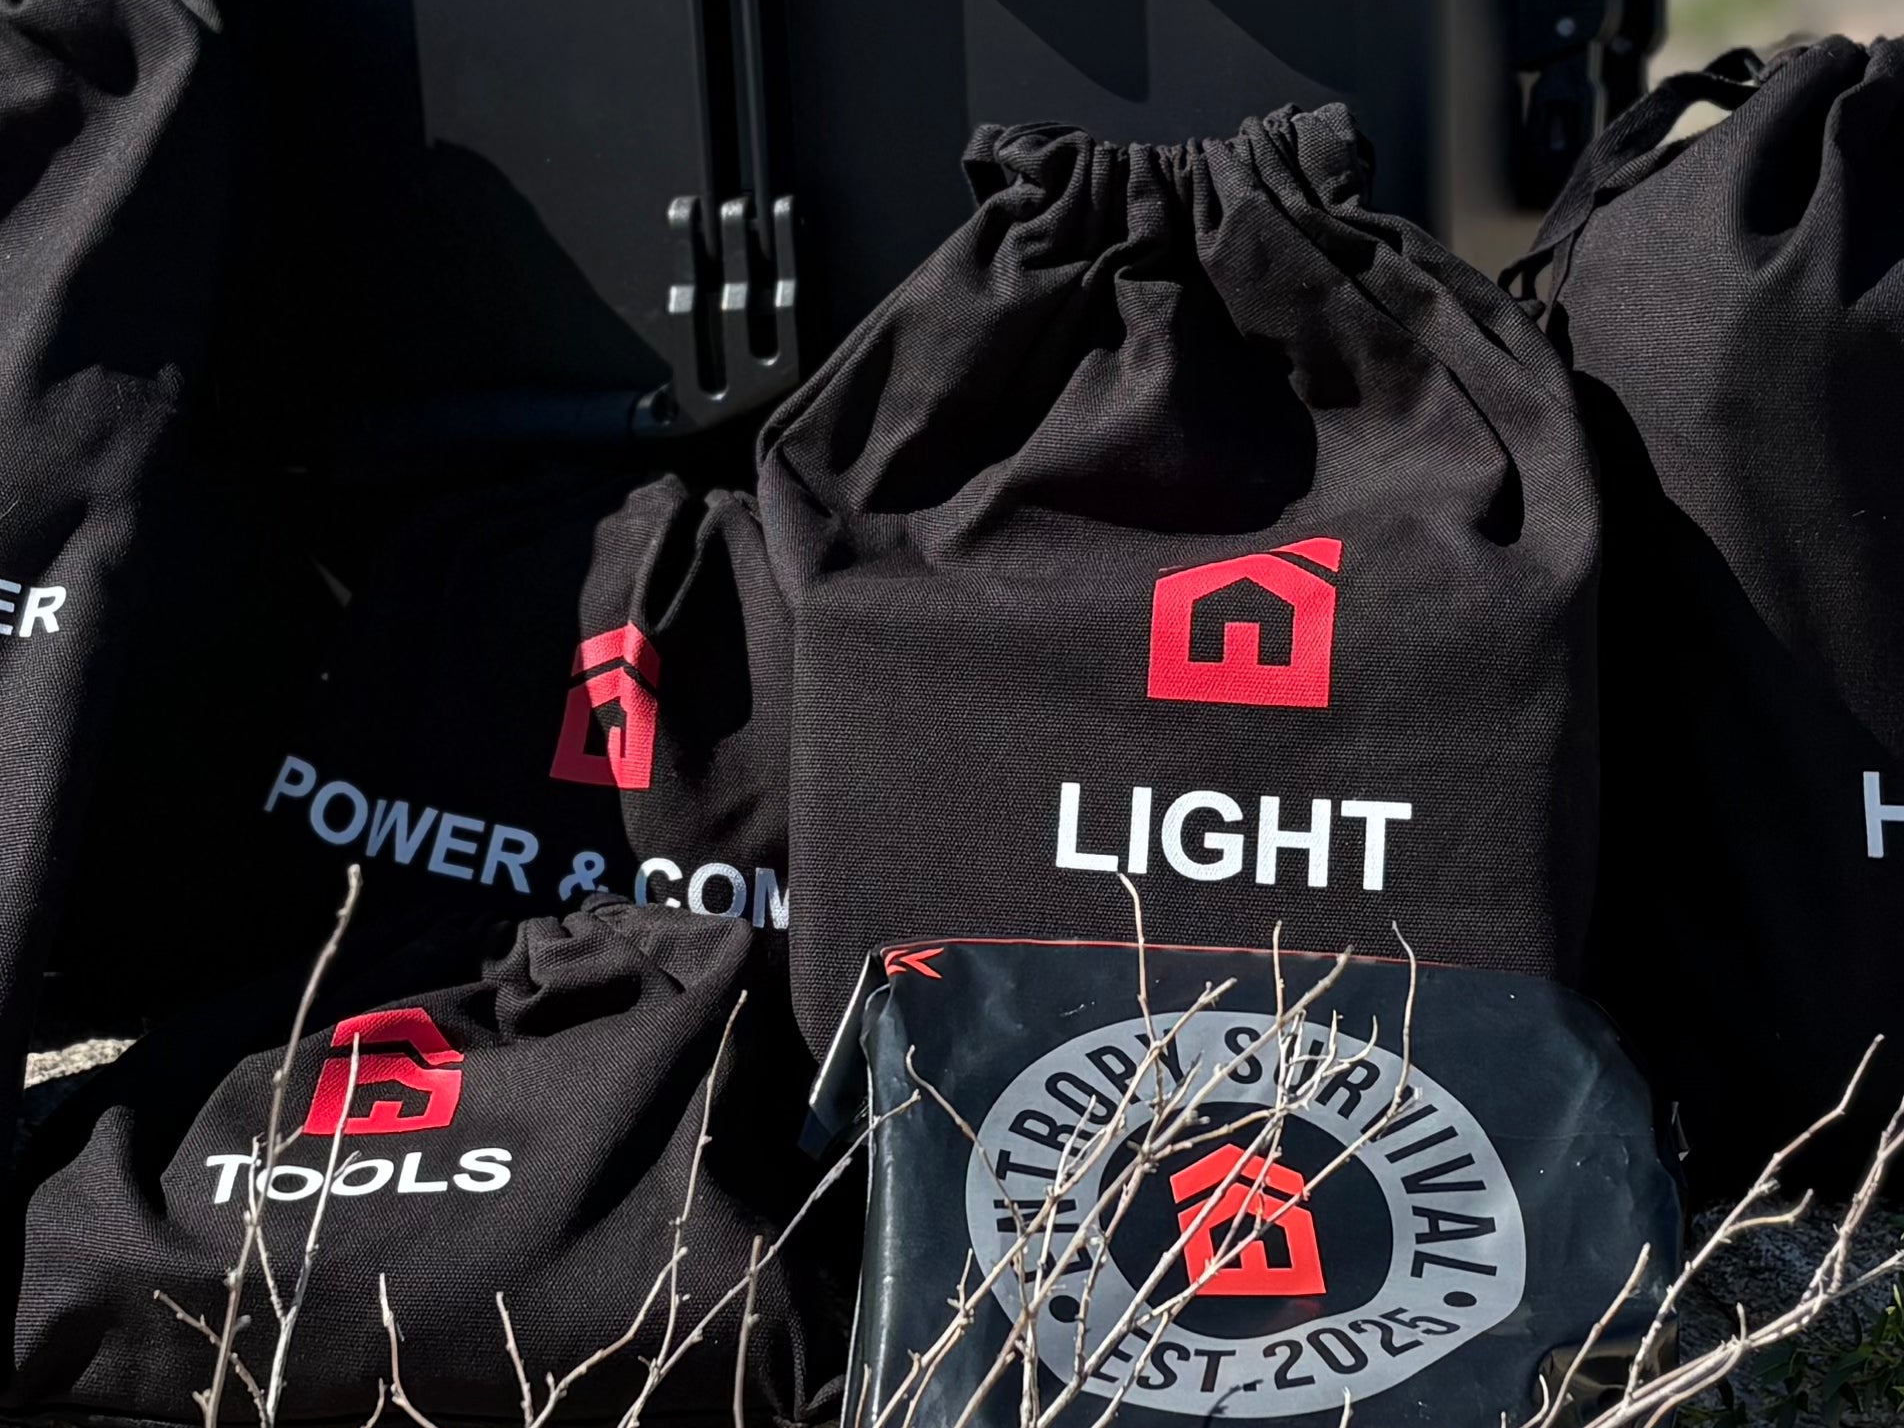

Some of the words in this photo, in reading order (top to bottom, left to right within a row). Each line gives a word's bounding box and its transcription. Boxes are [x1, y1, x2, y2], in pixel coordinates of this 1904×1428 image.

[264, 754, 539, 893] POWER
[558, 851, 609, 902] &
[635, 857, 790, 930] COM
[1056, 782, 1413, 891] LIGHT
[205, 1147, 512, 1204] TOOLS
[1223, 1026, 1498, 1280] SURVIVAL
